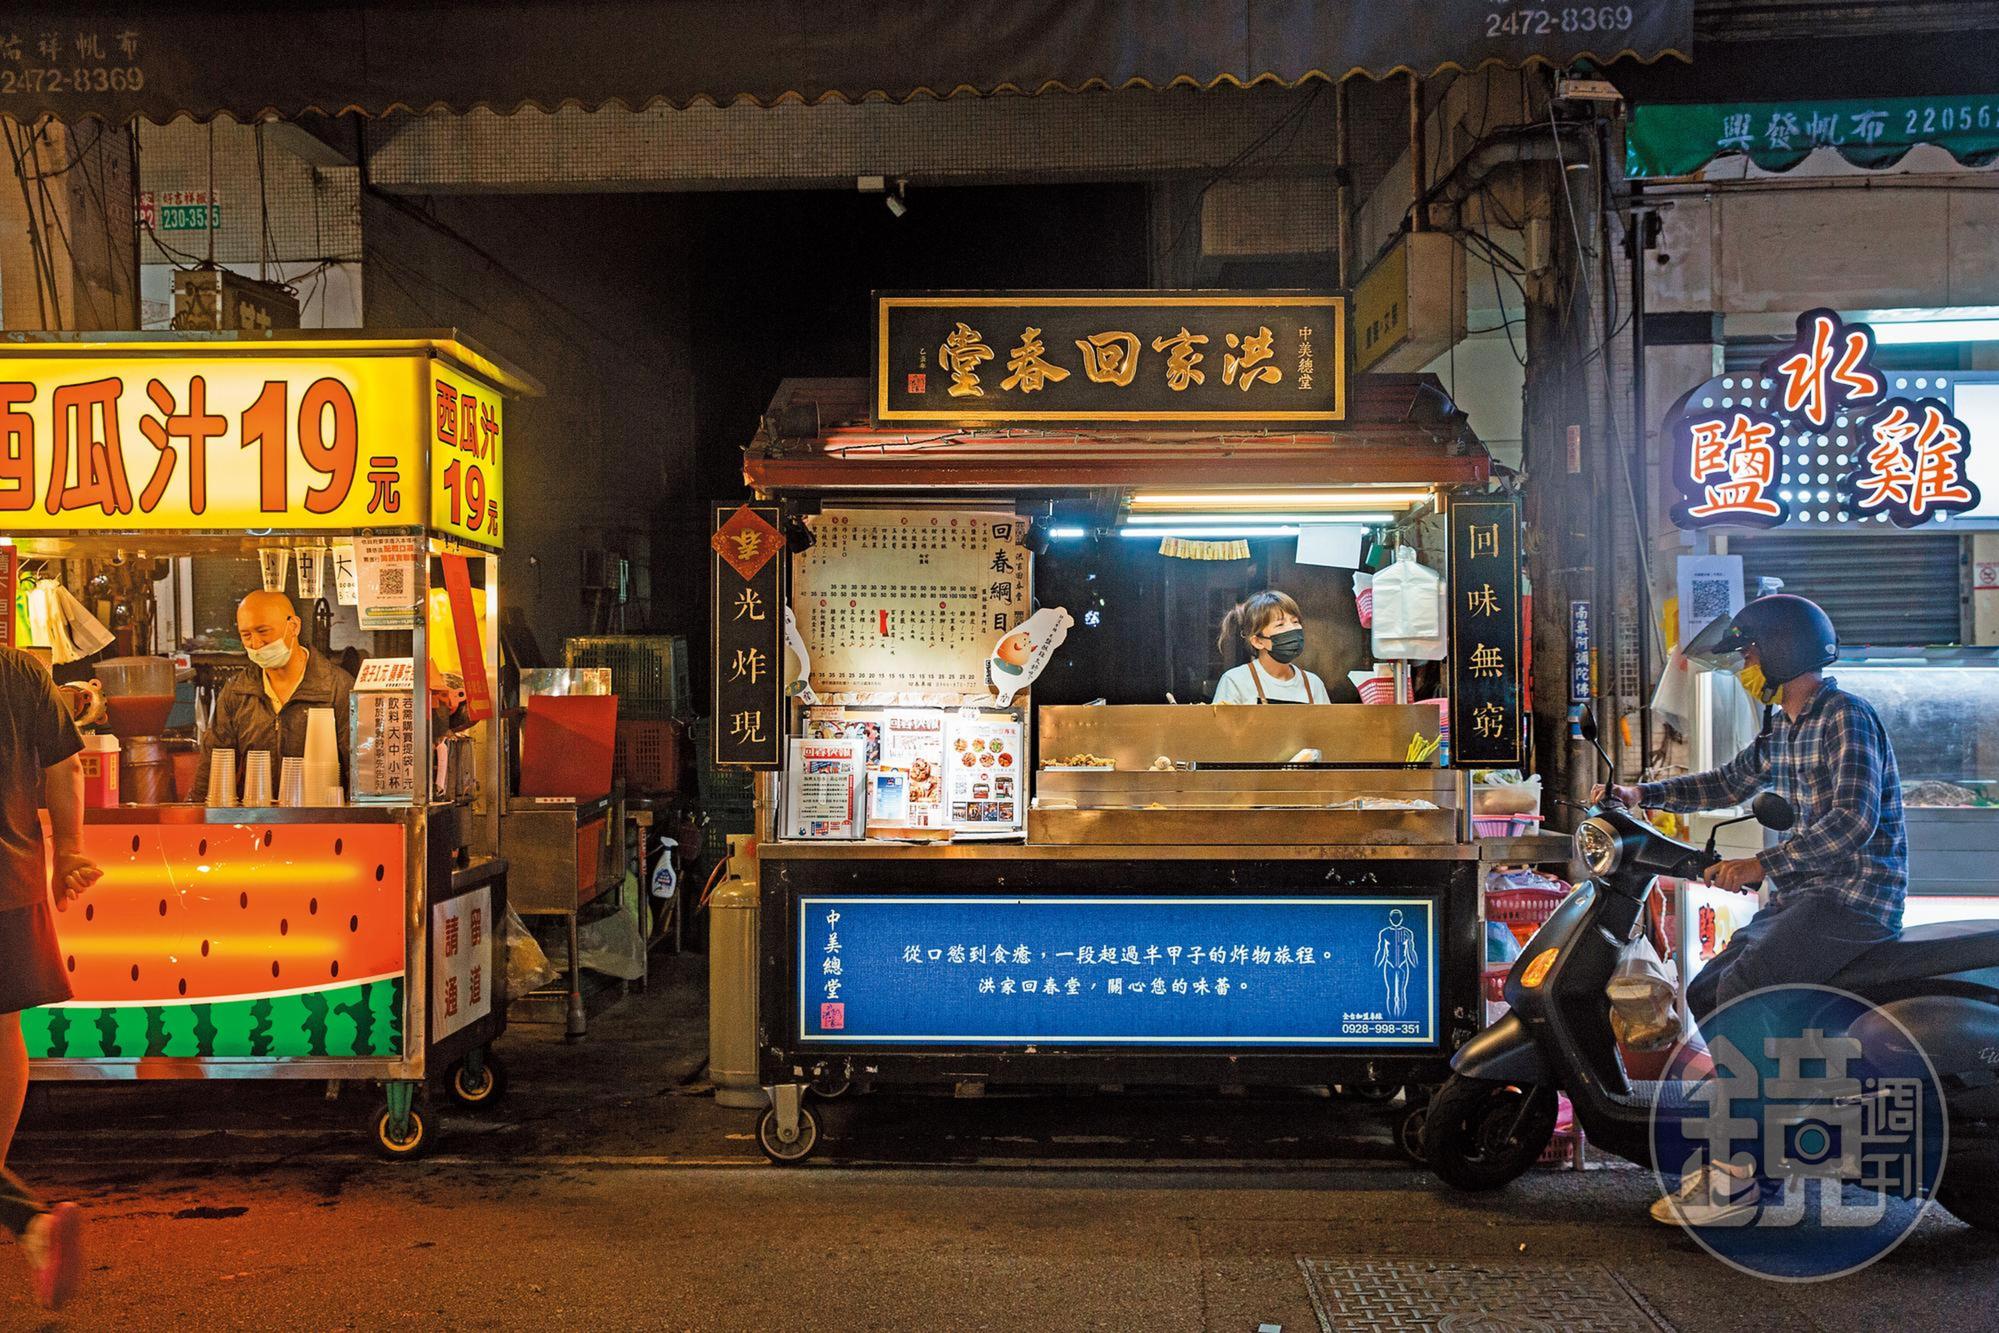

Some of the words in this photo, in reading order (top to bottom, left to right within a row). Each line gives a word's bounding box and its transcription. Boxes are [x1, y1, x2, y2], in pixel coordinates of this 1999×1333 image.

[1486, 5, 1633, 37] 2472-8369
[1, 67, 145, 94] 2472-8369
[1717, 109, 1889, 151] 興發帆布
[938, 322, 1283, 398] 洪家回春堂
[436, 379, 500, 466] 西瓜汁
[336, 554, 352, 580] 大
[990, 523, 1013, 634] 回春綱目
[728, 588, 766, 745] 光炸現
[1467, 523, 1504, 738] 回味無窮
[1574, 606, 1590, 700] 南無阿彌陀佛
[388, 697, 400, 789] 飲料大中小杯
[823, 909, 843, 999] 中美總堂
[1342, 1024, 1420, 1034] 0928-998-351
